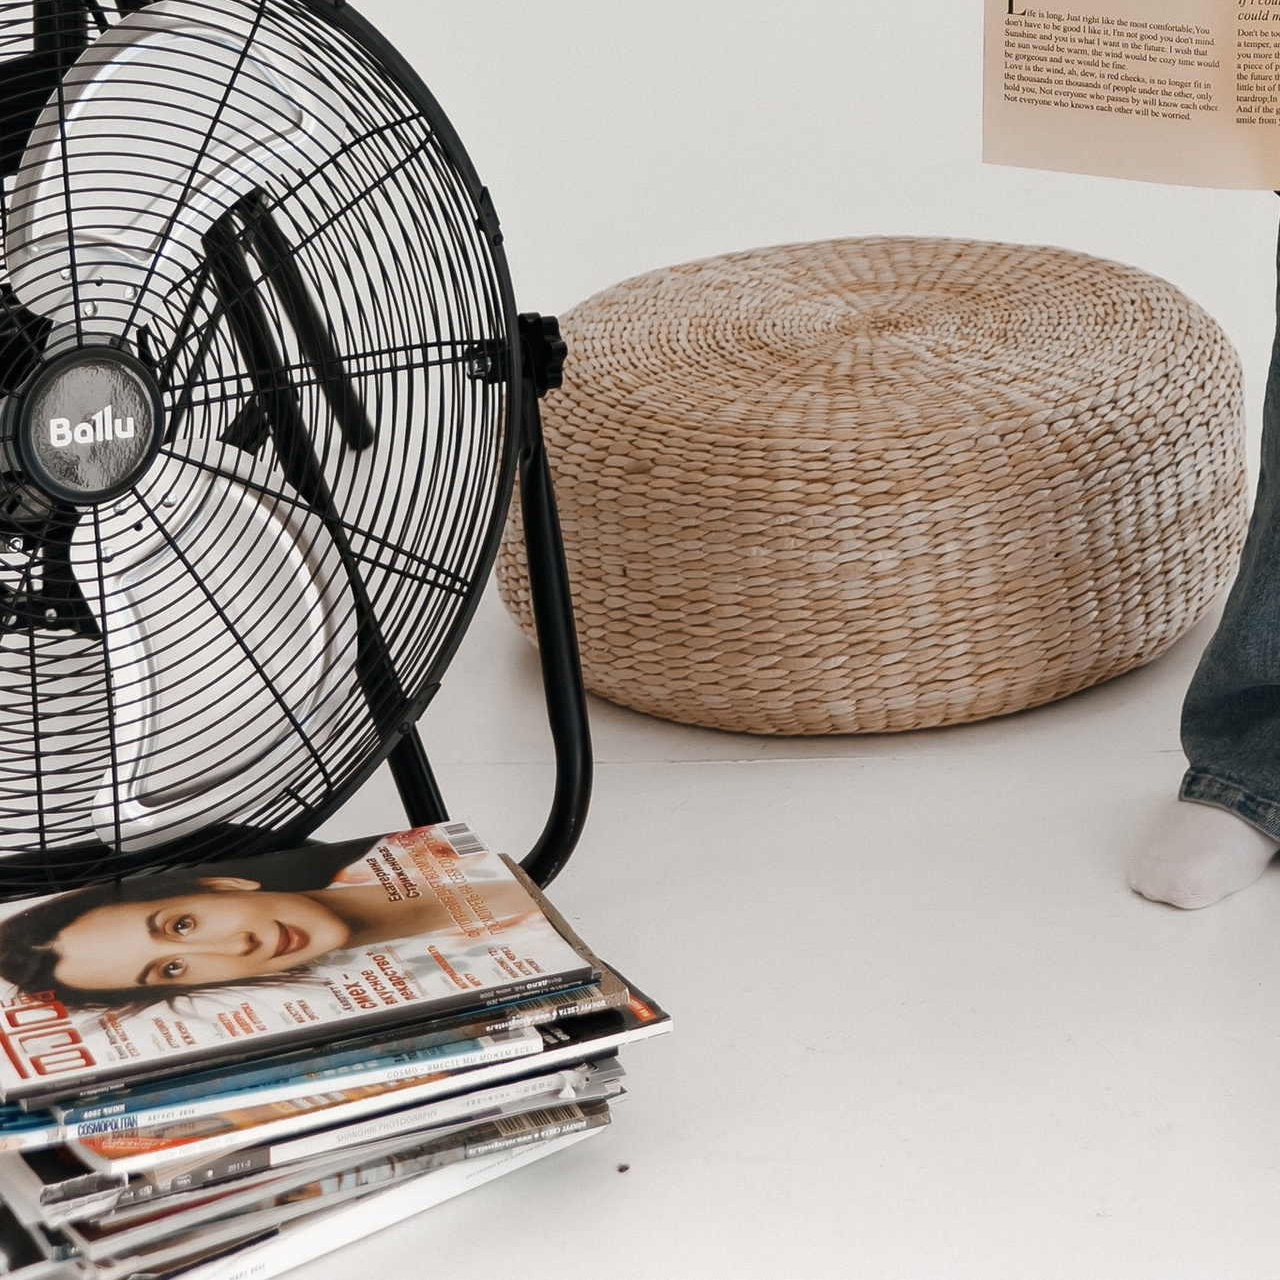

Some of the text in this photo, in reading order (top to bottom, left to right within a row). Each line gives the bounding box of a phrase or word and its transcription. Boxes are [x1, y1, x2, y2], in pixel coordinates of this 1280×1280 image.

[1238, 10, 1270, 21] could
[50, 405, 134, 447] Ballu
[363, 856, 404, 902] Екатерина
[375, 845, 424, 899] Стриженова:
[342, 980, 379, 1010] смех
[358, 968, 401, 1005] вкусное
[386, 1067, 418, 1080] COSMO
[427, 1059, 460, 1072] ВМЕСТЕ
[463, 1055, 477, 1065] МЫ
[480, 1050, 512, 1063] МОЖЕМ
[77, 1115, 139, 1137] COSMOPOLITAN
[83, 1110, 102, 1119] 2009
